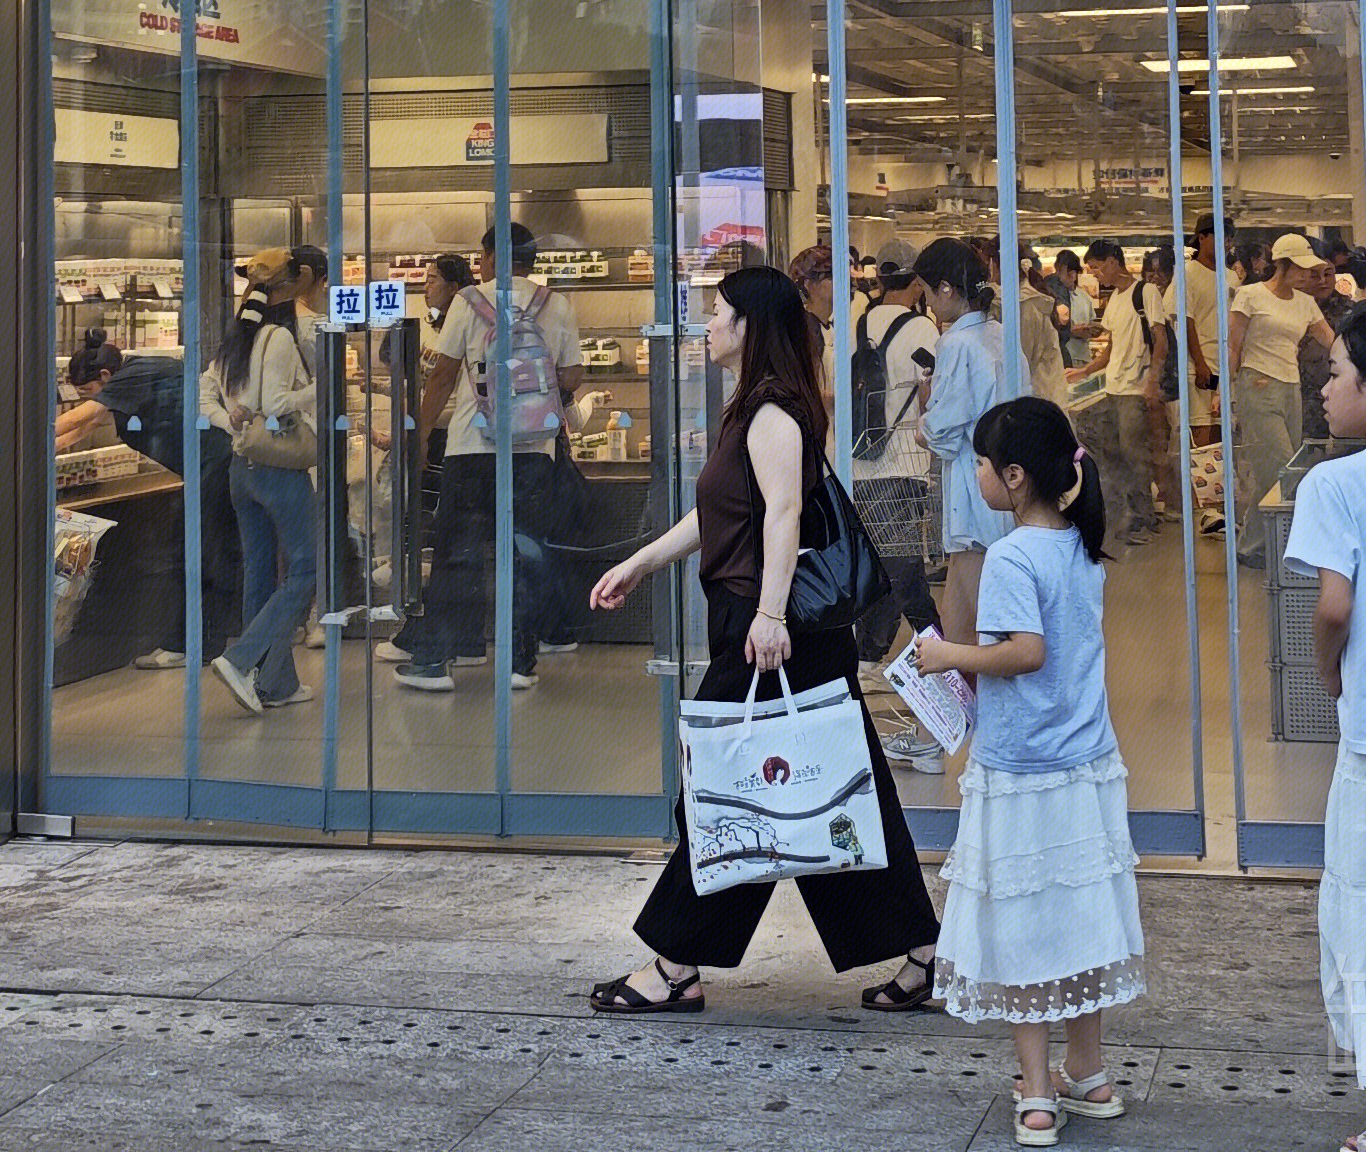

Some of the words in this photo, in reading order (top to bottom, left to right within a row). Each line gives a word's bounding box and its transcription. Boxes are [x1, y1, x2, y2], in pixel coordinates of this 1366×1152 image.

[139, 11, 168, 31] COLD
[336, 288, 361, 315] 拉
[375, 283, 400, 310] 拉
